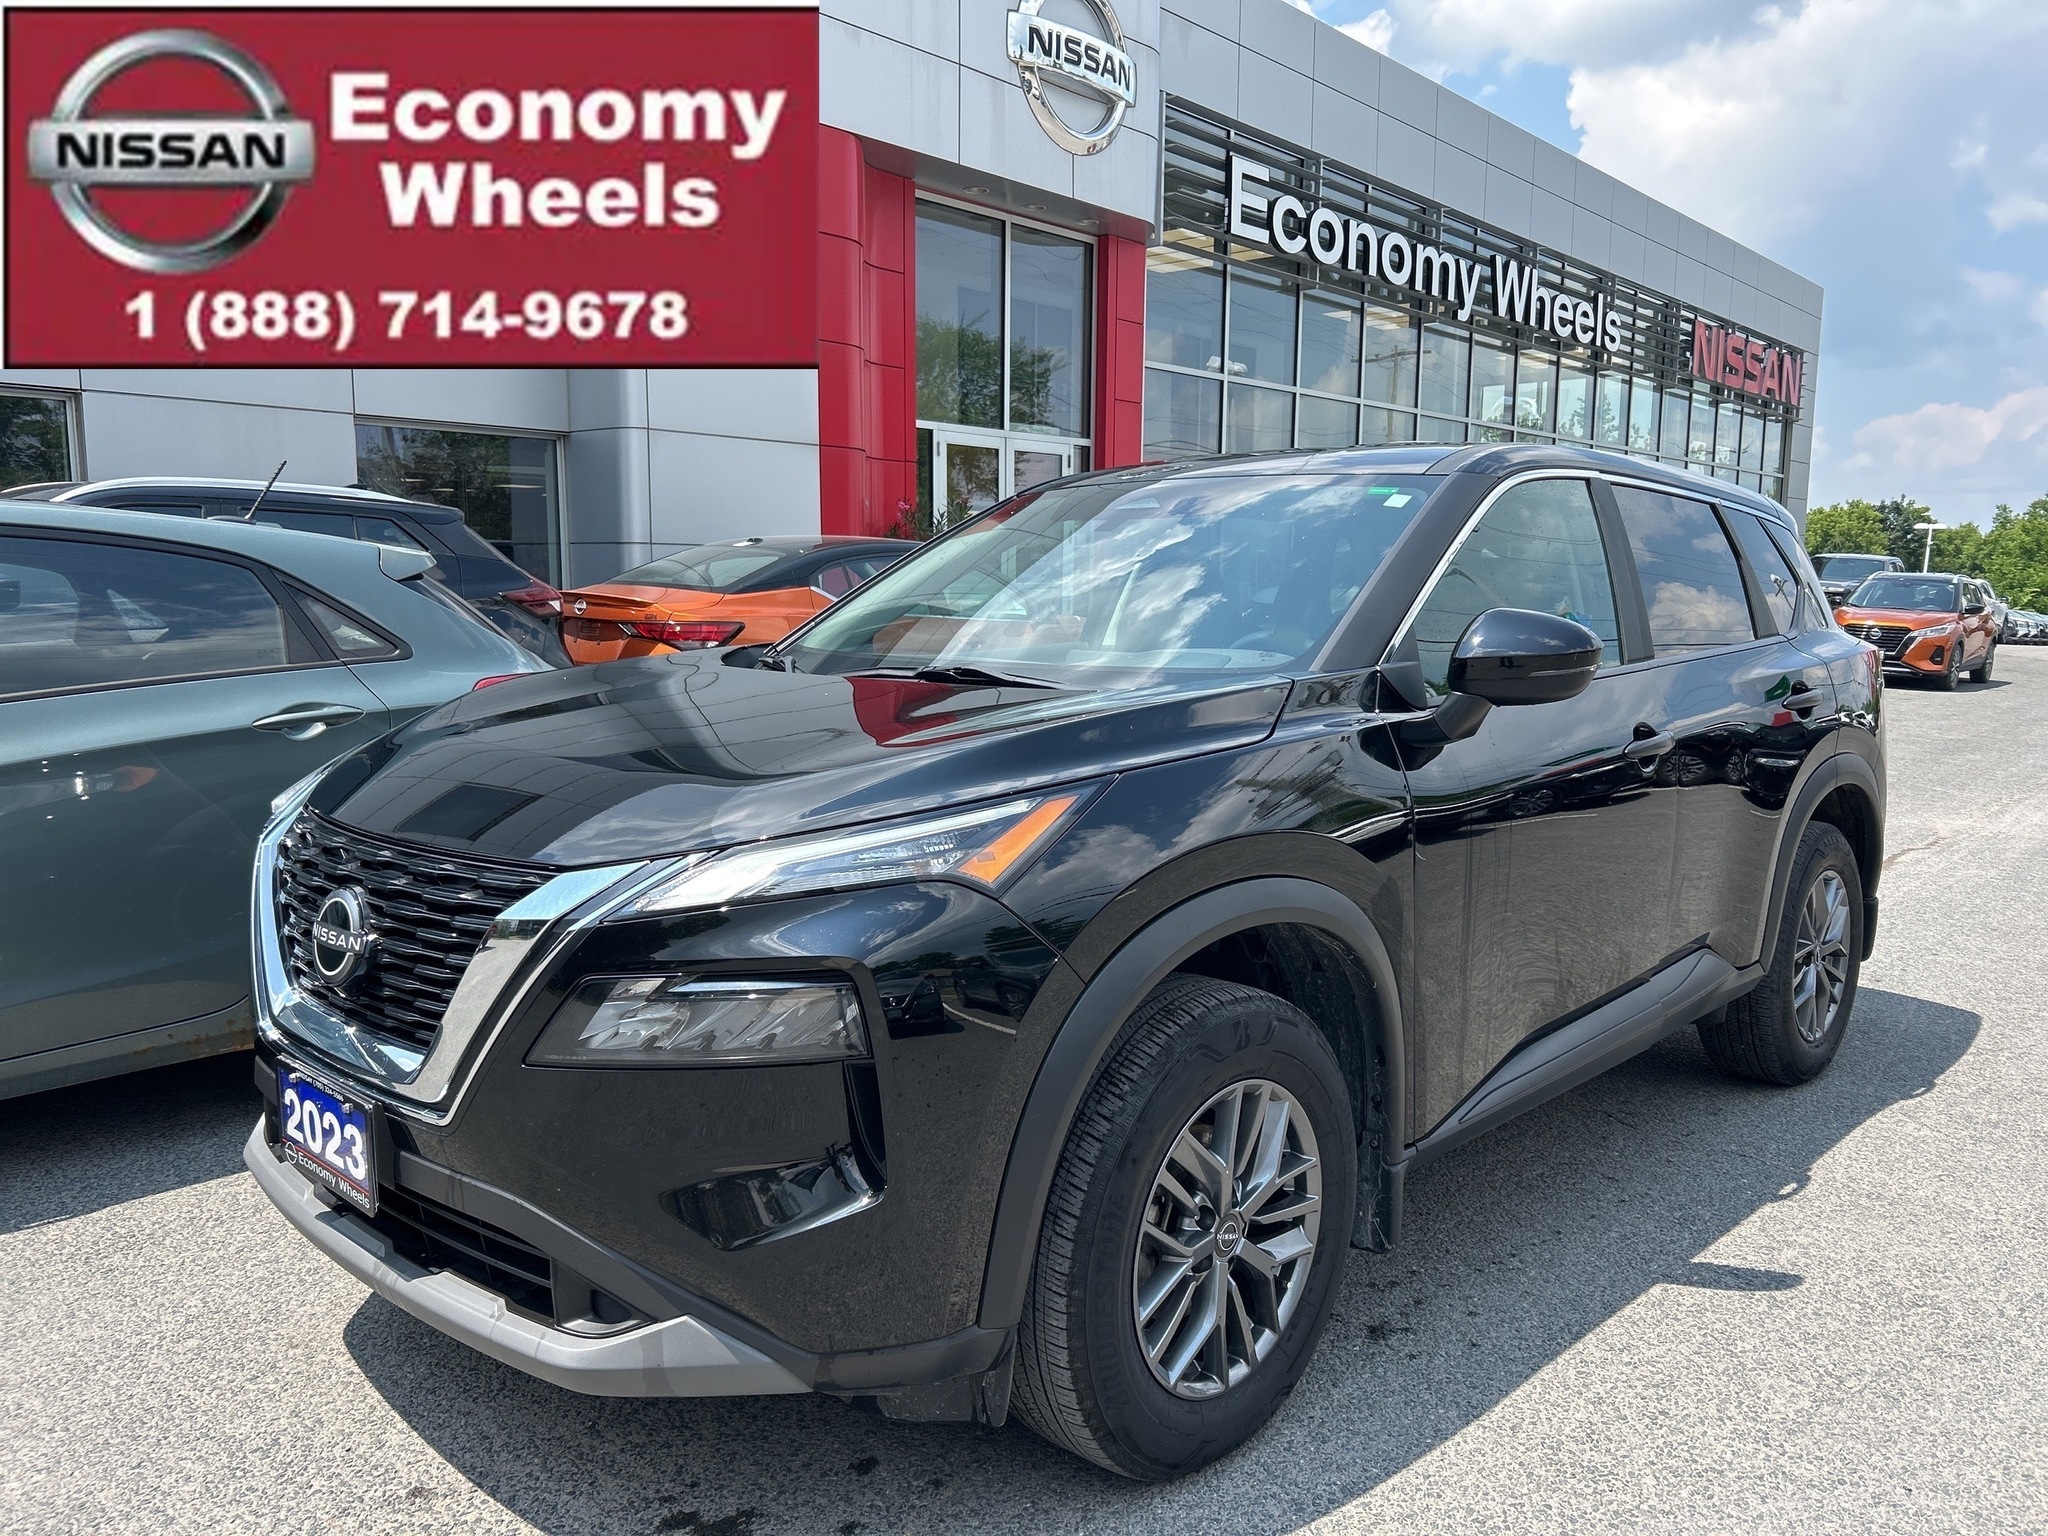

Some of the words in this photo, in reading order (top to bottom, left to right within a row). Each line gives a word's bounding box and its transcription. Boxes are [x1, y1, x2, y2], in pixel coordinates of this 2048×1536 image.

[1028, 24, 1132, 91] NISSAN
[1226, 154, 1482, 321] Economy
[1490, 253, 1622, 353] Wheels
[1692, 319, 1800, 407] NISSAN
[313, 921, 361, 951] NISSAN
[284, 1088, 366, 1180] 2023
[298, 1152, 337, 1187] Economy
[338, 1177, 370, 1209] Wheels
